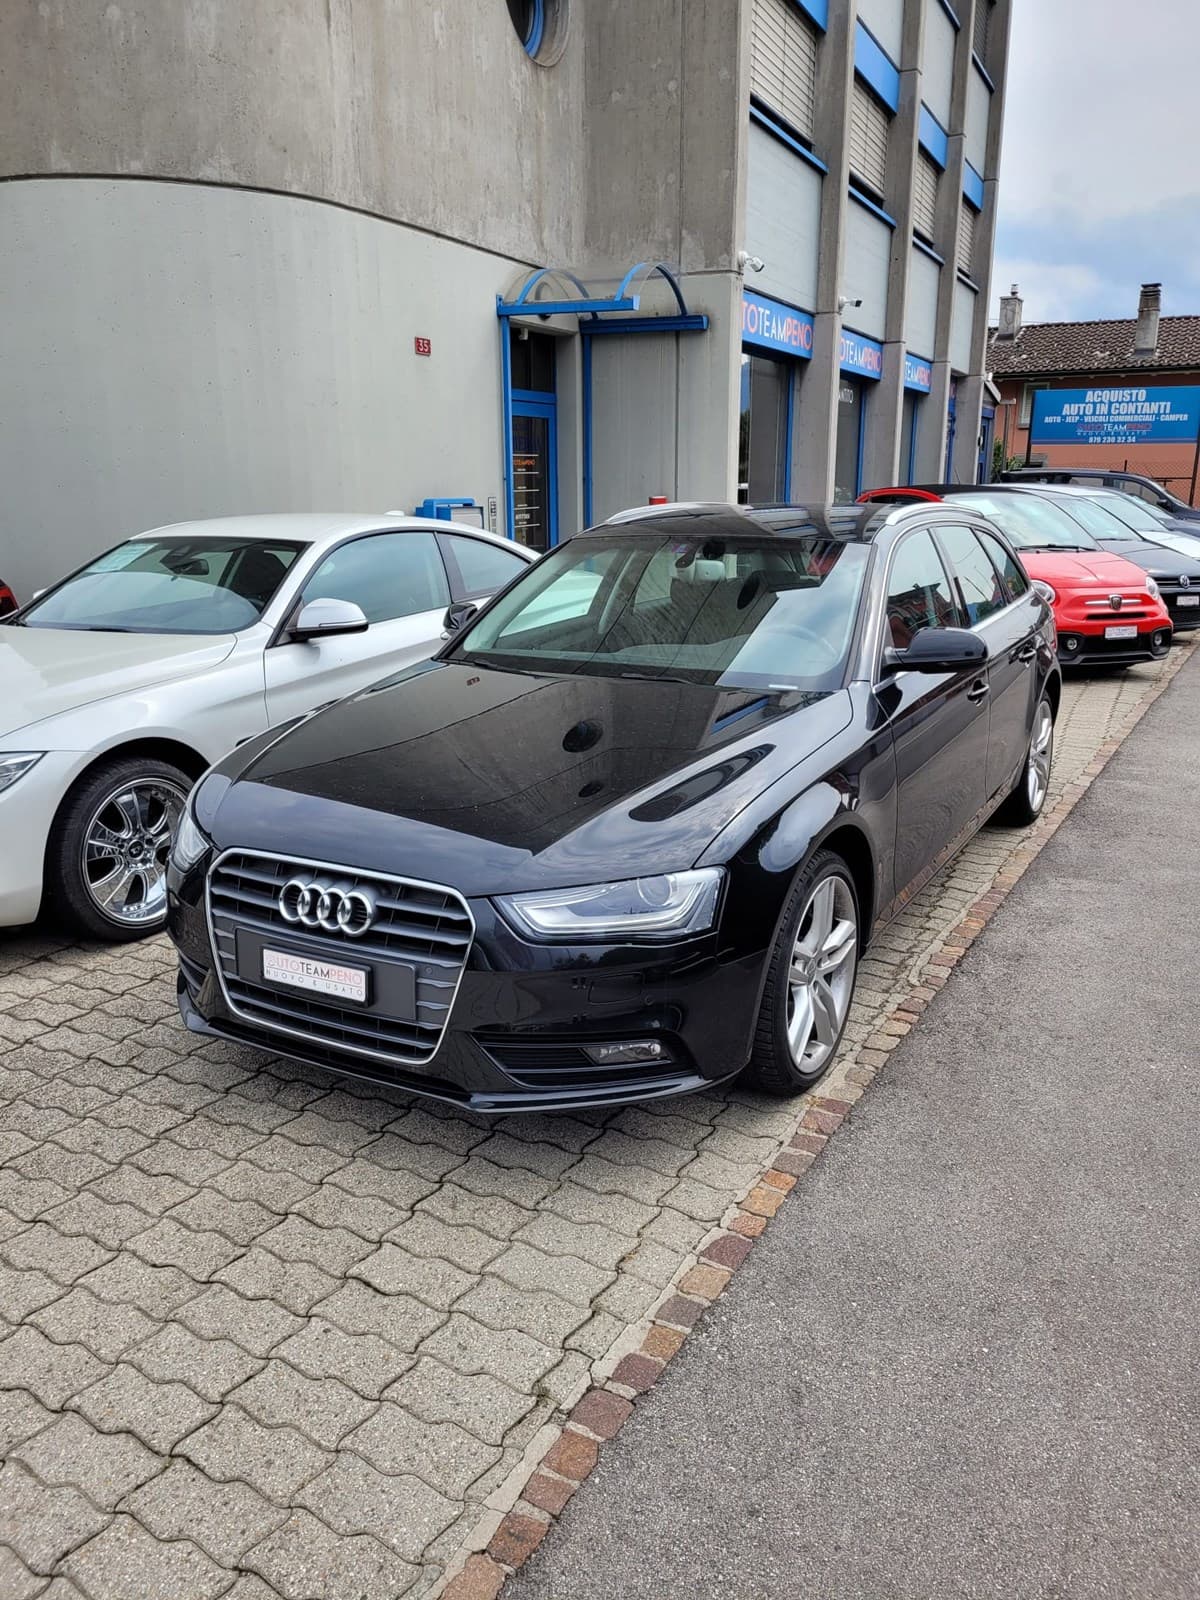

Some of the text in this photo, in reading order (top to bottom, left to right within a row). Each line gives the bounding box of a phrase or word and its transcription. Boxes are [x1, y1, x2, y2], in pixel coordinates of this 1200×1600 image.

[418, 340, 429, 352] 35
[1085, 390, 1146, 403] ACQUISTO
[1062, 402, 1171, 415] AUTO IN CONTANTI
[1109, 414, 1156, 422] COMMERCIALI
[325, 982, 363, 996] USATO
